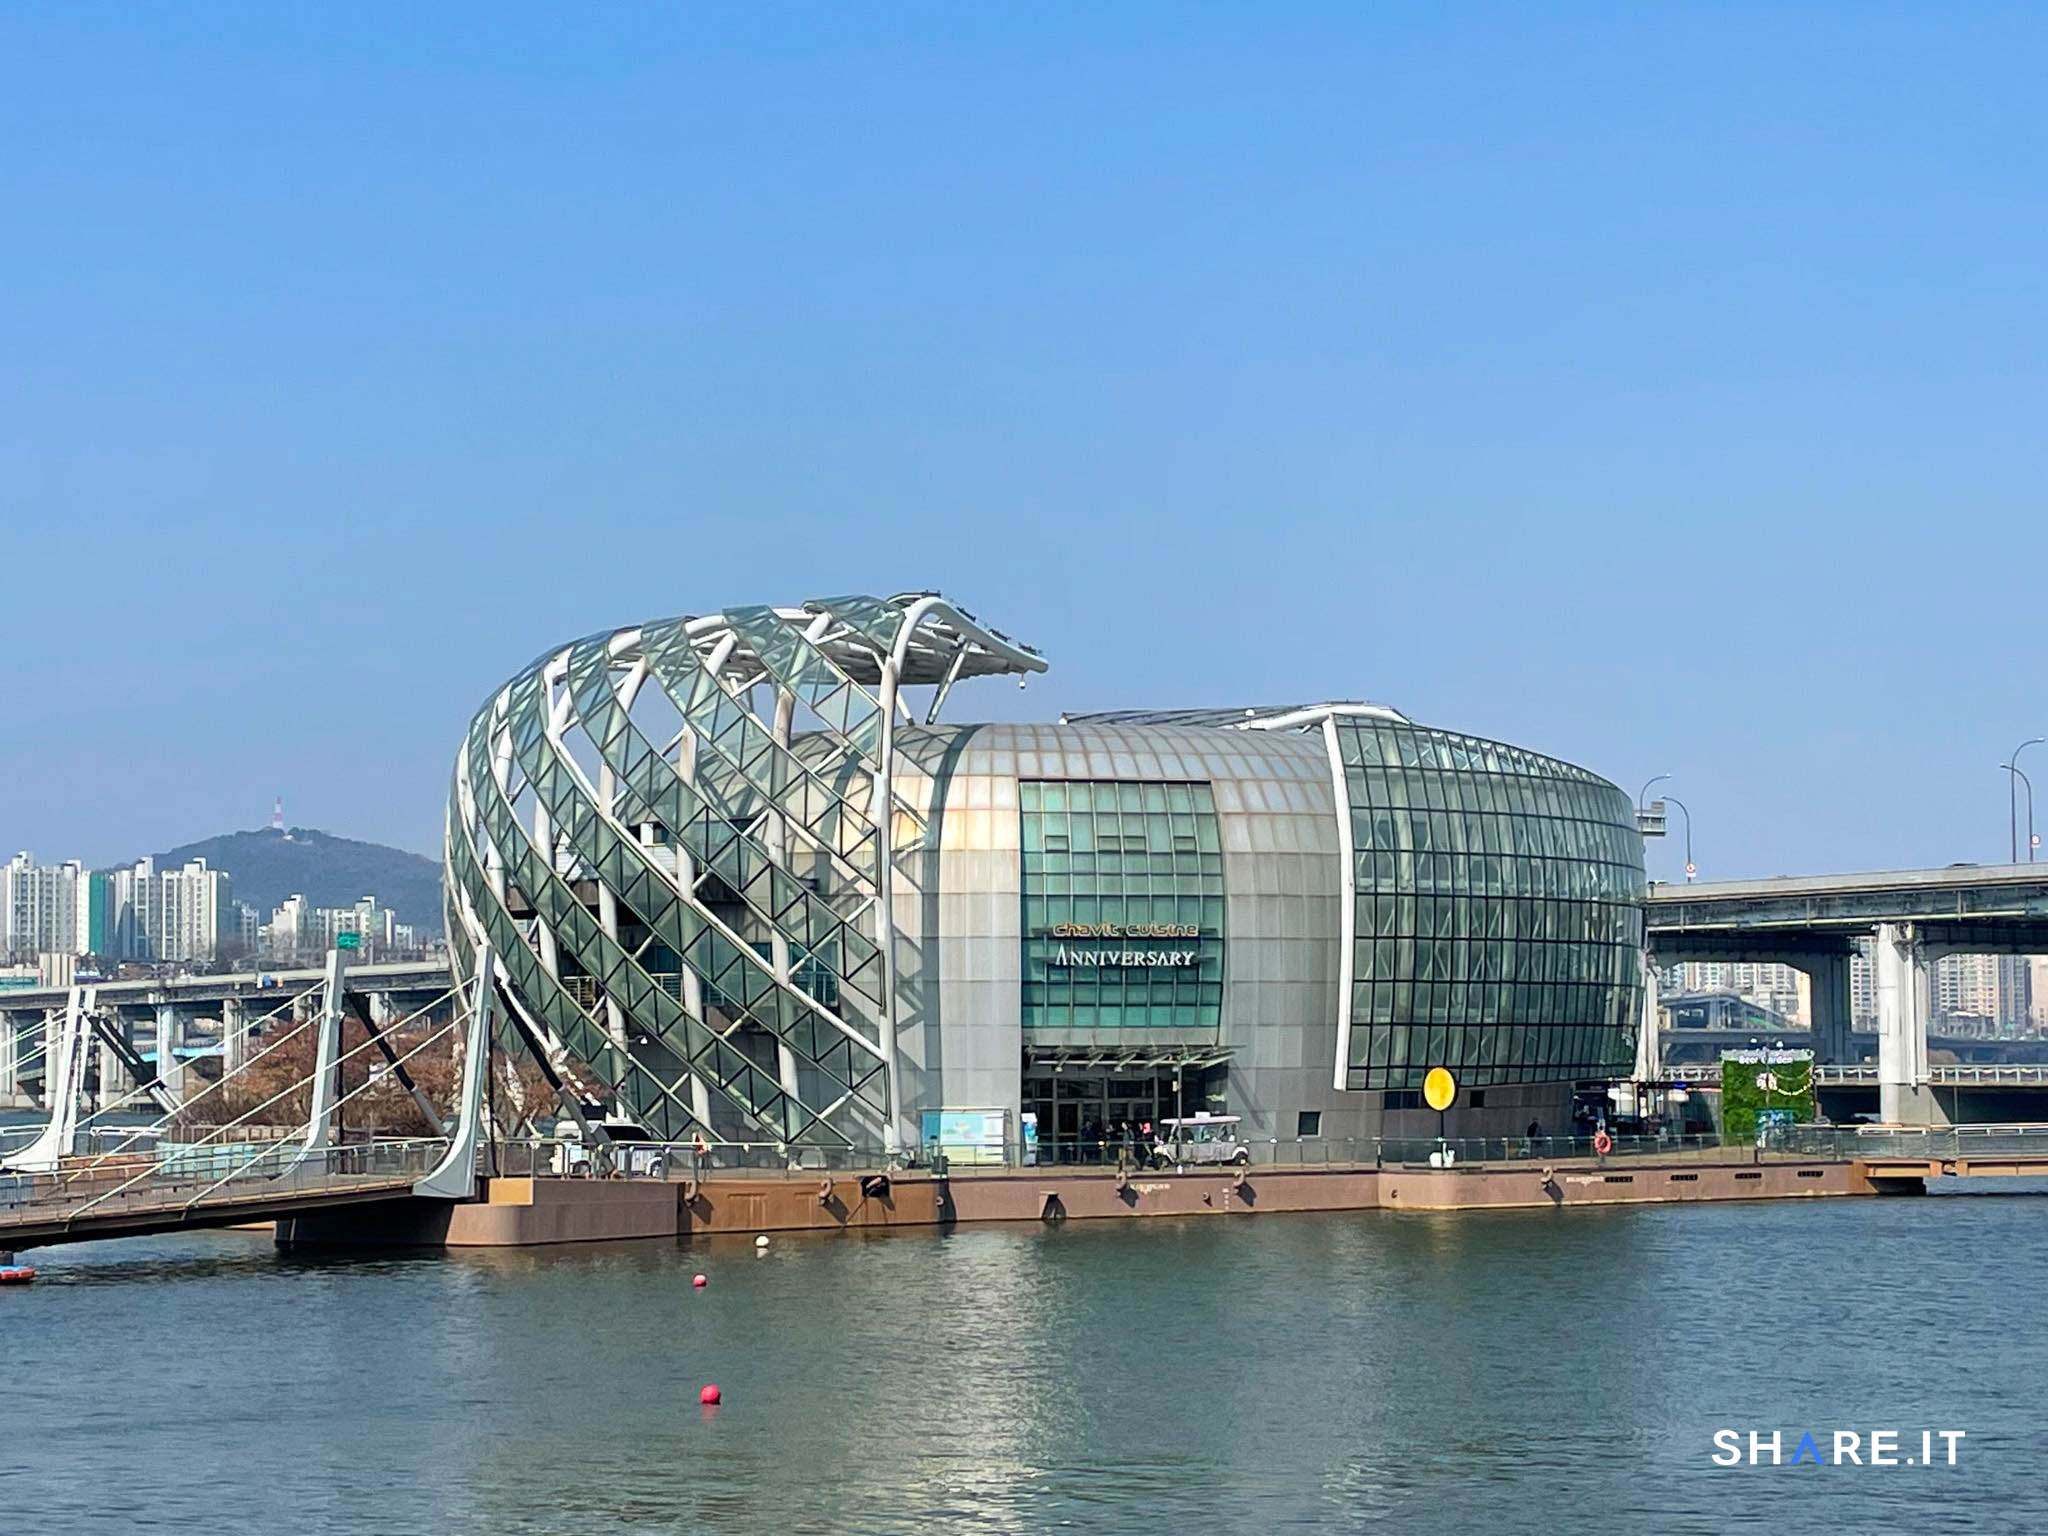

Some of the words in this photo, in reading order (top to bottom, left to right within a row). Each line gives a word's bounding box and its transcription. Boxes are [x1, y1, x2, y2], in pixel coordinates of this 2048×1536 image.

[1054, 923, 1118, 936] chavit
[1126, 923, 1199, 936] cuisine
[1055, 943, 1194, 966] ANNIVERSARY
